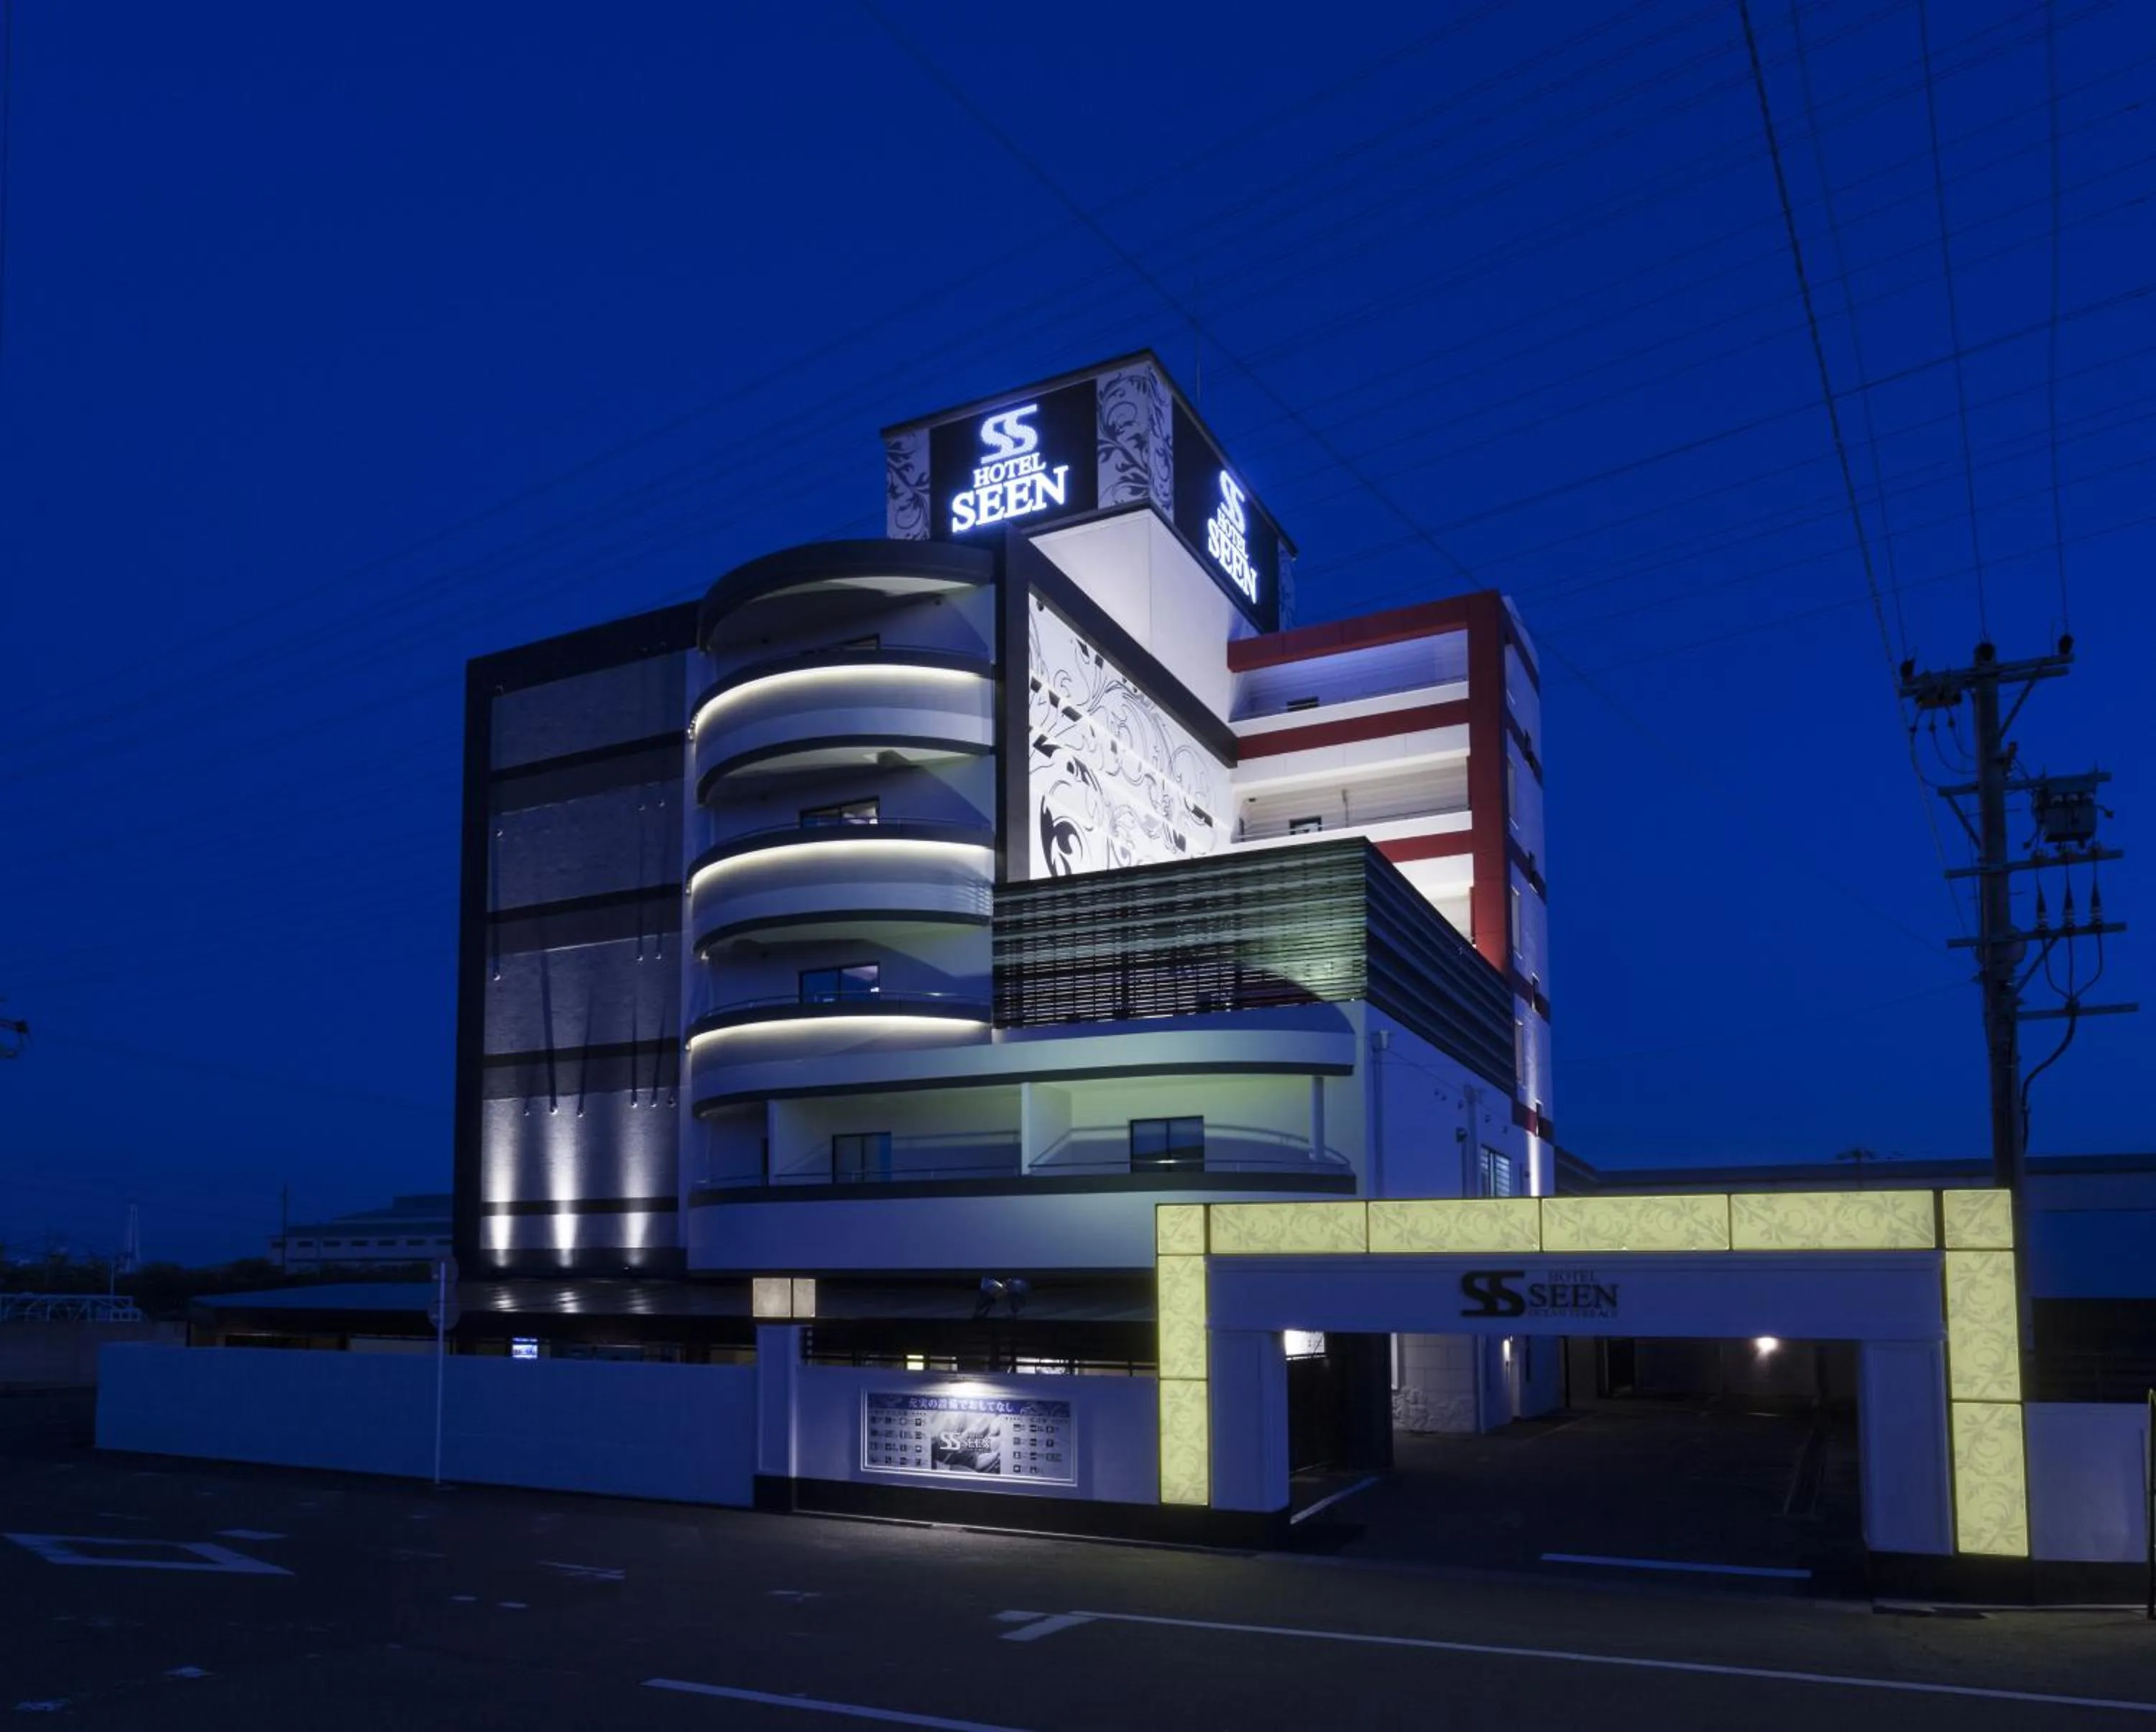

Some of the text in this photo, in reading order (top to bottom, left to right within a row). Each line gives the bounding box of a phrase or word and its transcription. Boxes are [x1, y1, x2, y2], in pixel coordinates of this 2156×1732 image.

[973, 452, 1046, 489] HOTEL
[952, 465, 1069, 533] SEEN
[1217, 507, 1249, 560] HOTEL
[1207, 517, 1257, 604] SEEN
[1528, 1284, 1620, 1308] SEEN
[1548, 1269, 1595, 1283] HOTEL
